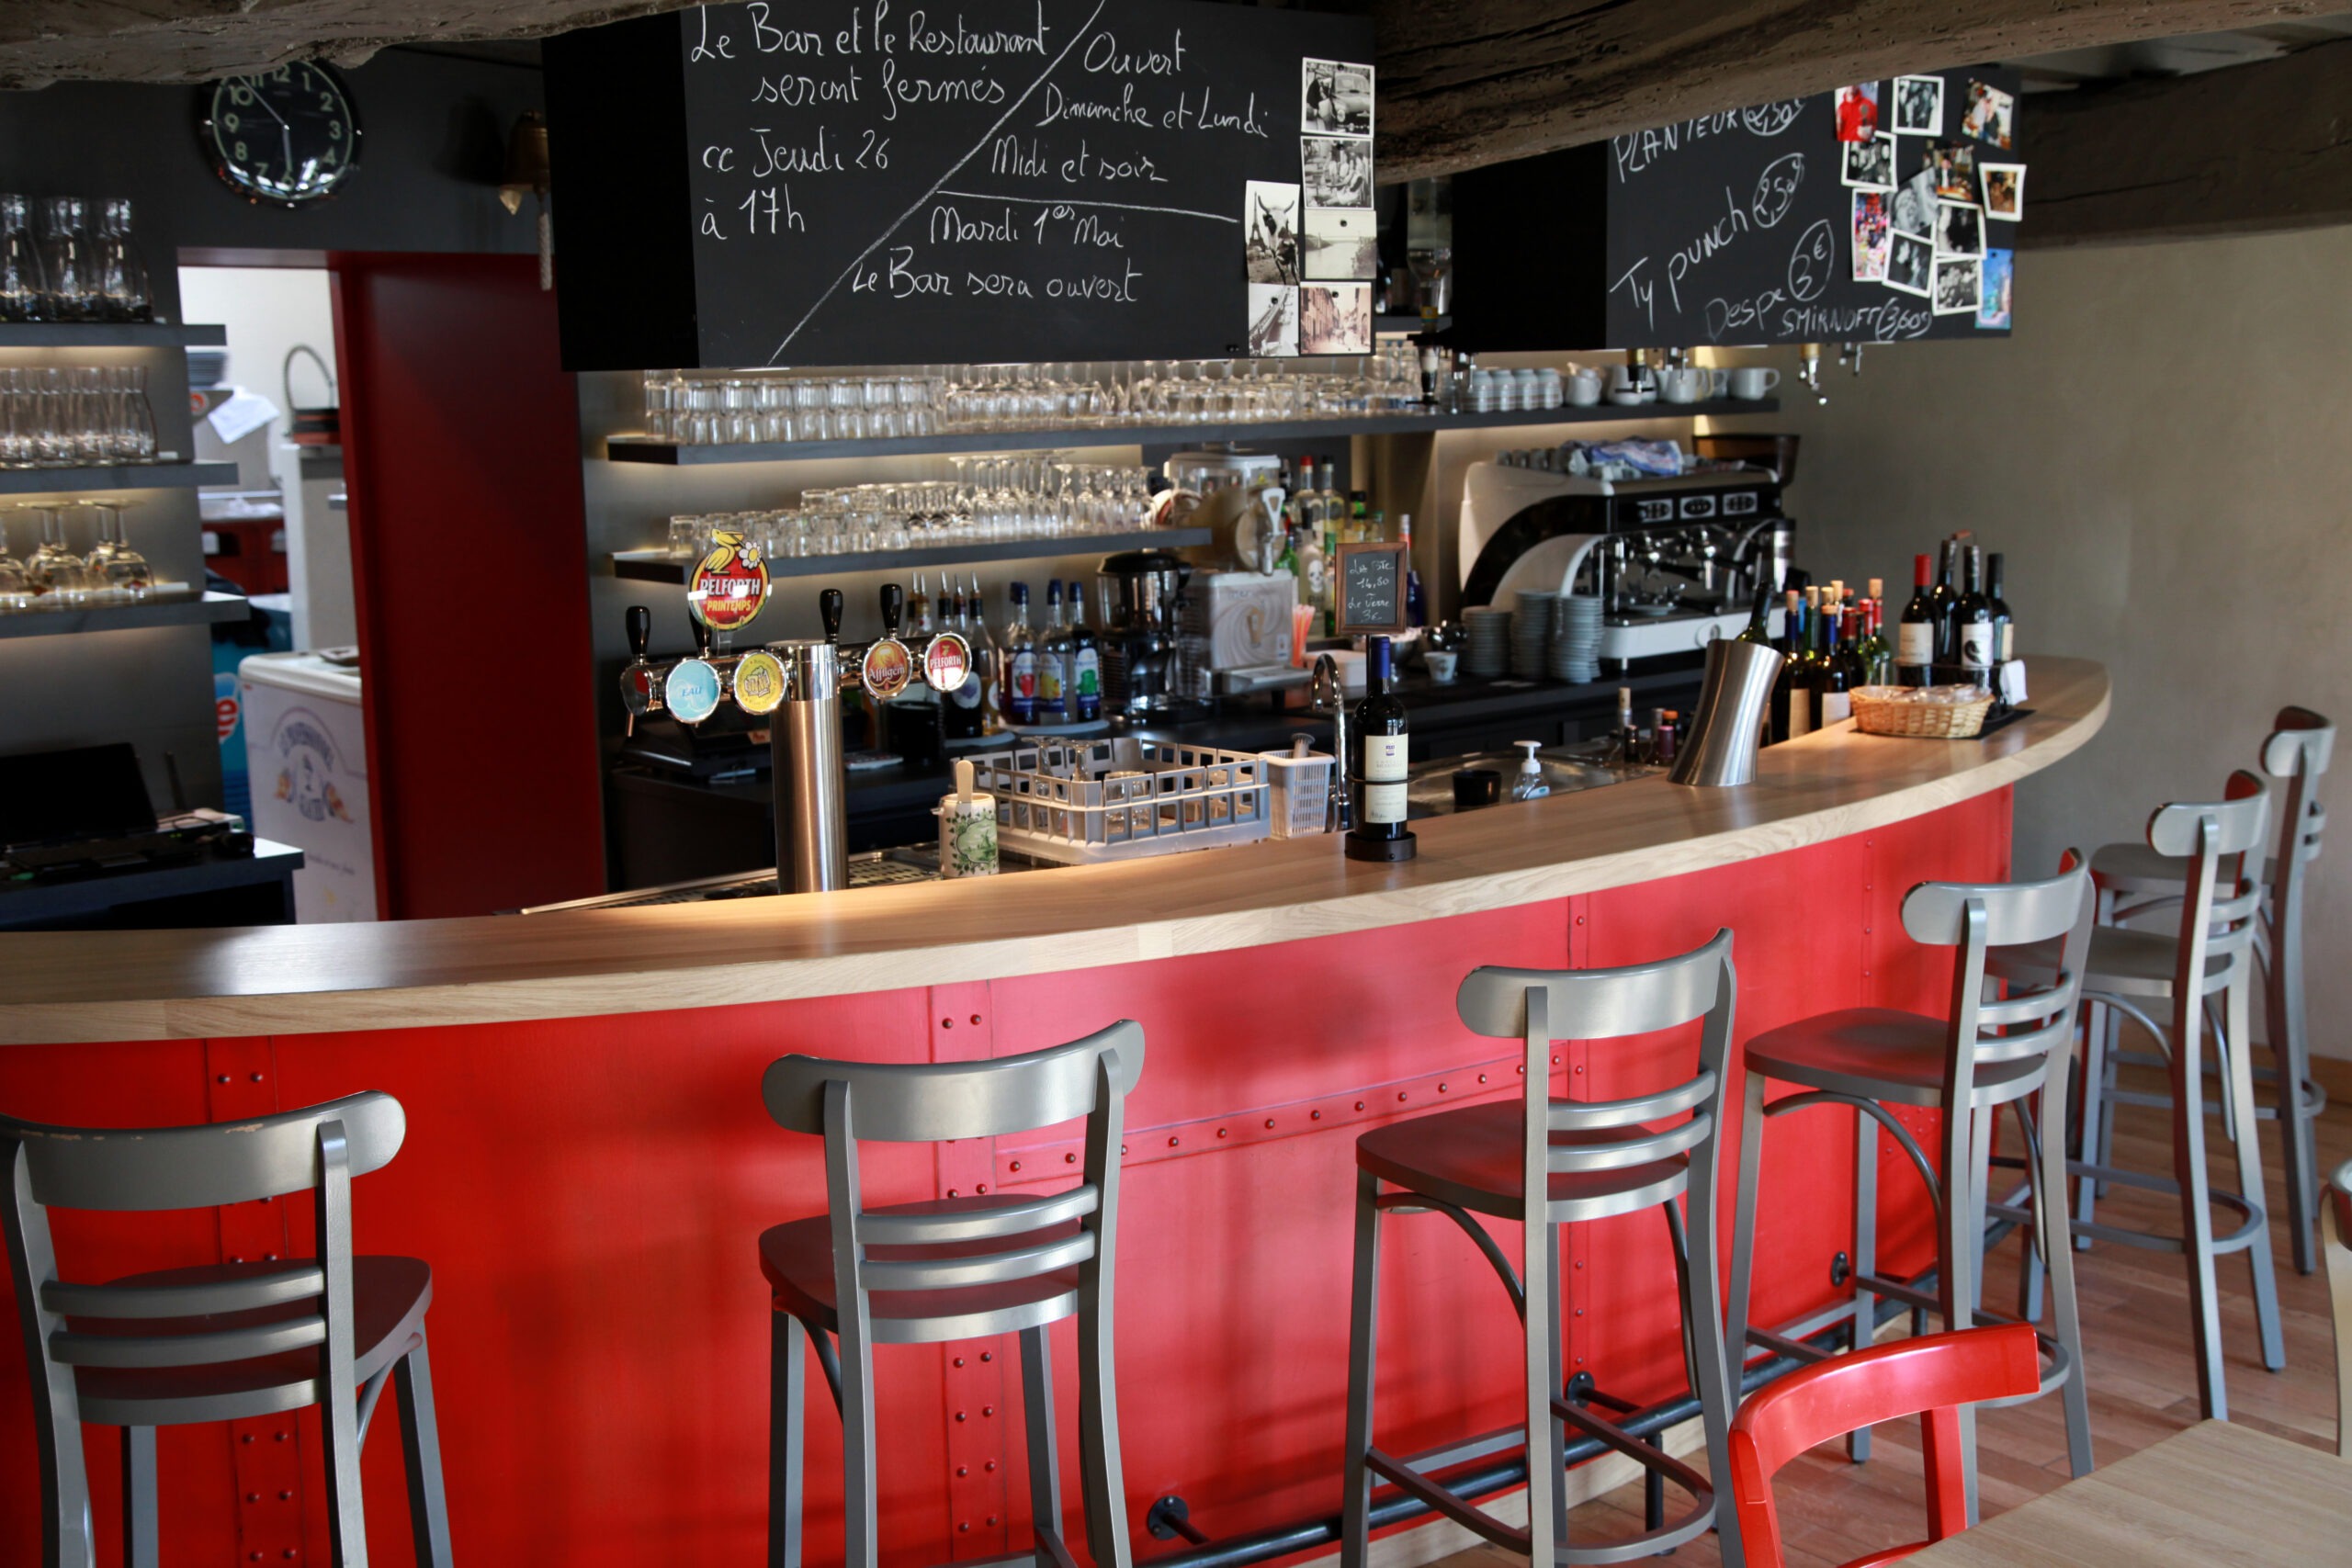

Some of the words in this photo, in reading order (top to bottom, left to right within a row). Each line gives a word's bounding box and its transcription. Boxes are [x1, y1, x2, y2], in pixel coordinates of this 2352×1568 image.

[691, 4, 735, 62] Le
[747, 2, 824, 57] Bar
[836, 6, 865, 54] et
[874, 0, 896, 52] le
[909, 0, 1050, 56] Restaurant
[1084, 28, 1187, 76] Ouvert
[301, 72, 311, 92] 1
[751, 64, 862, 106] seront
[882, 58, 1005, 120] fermés
[229, 85, 254, 107] 10
[320, 92, 334, 112] 2
[1036, 82, 1153, 128] Dimanche
[1163, 92, 1193, 129] et
[1198, 85, 1269, 139] Lundi
[224, 113, 240, 134] 9
[329, 120, 342, 140] 3
[234, 141, 248, 162] 8
[322, 145, 337, 166] 4
[750, 126, 843, 177] Jeudi
[855, 130, 890, 170] 26
[991, 133, 1047, 177] Midi
[1061, 140, 1090, 182] et
[1099, 141, 1168, 182] soir
[701, 198, 728, 240] à
[739, 183, 806, 234] 17h
[930, 206, 1019, 244] Mardi
[1074, 215, 1125, 248] Mai
[1609, 256, 1655, 332] Ty
[1668, 186, 1748, 313] punch
[853, 262, 876, 292] Le
[888, 245, 953, 299] Bar
[967, 272, 1034, 299] sera
[1046, 257, 1144, 302] ouvert
[707, 599, 752, 612] PRINTEMPS
[930, 655, 962, 670] PELFORTH
[868, 666, 905, 682] Affligem
[682, 686, 702, 697] EAU
